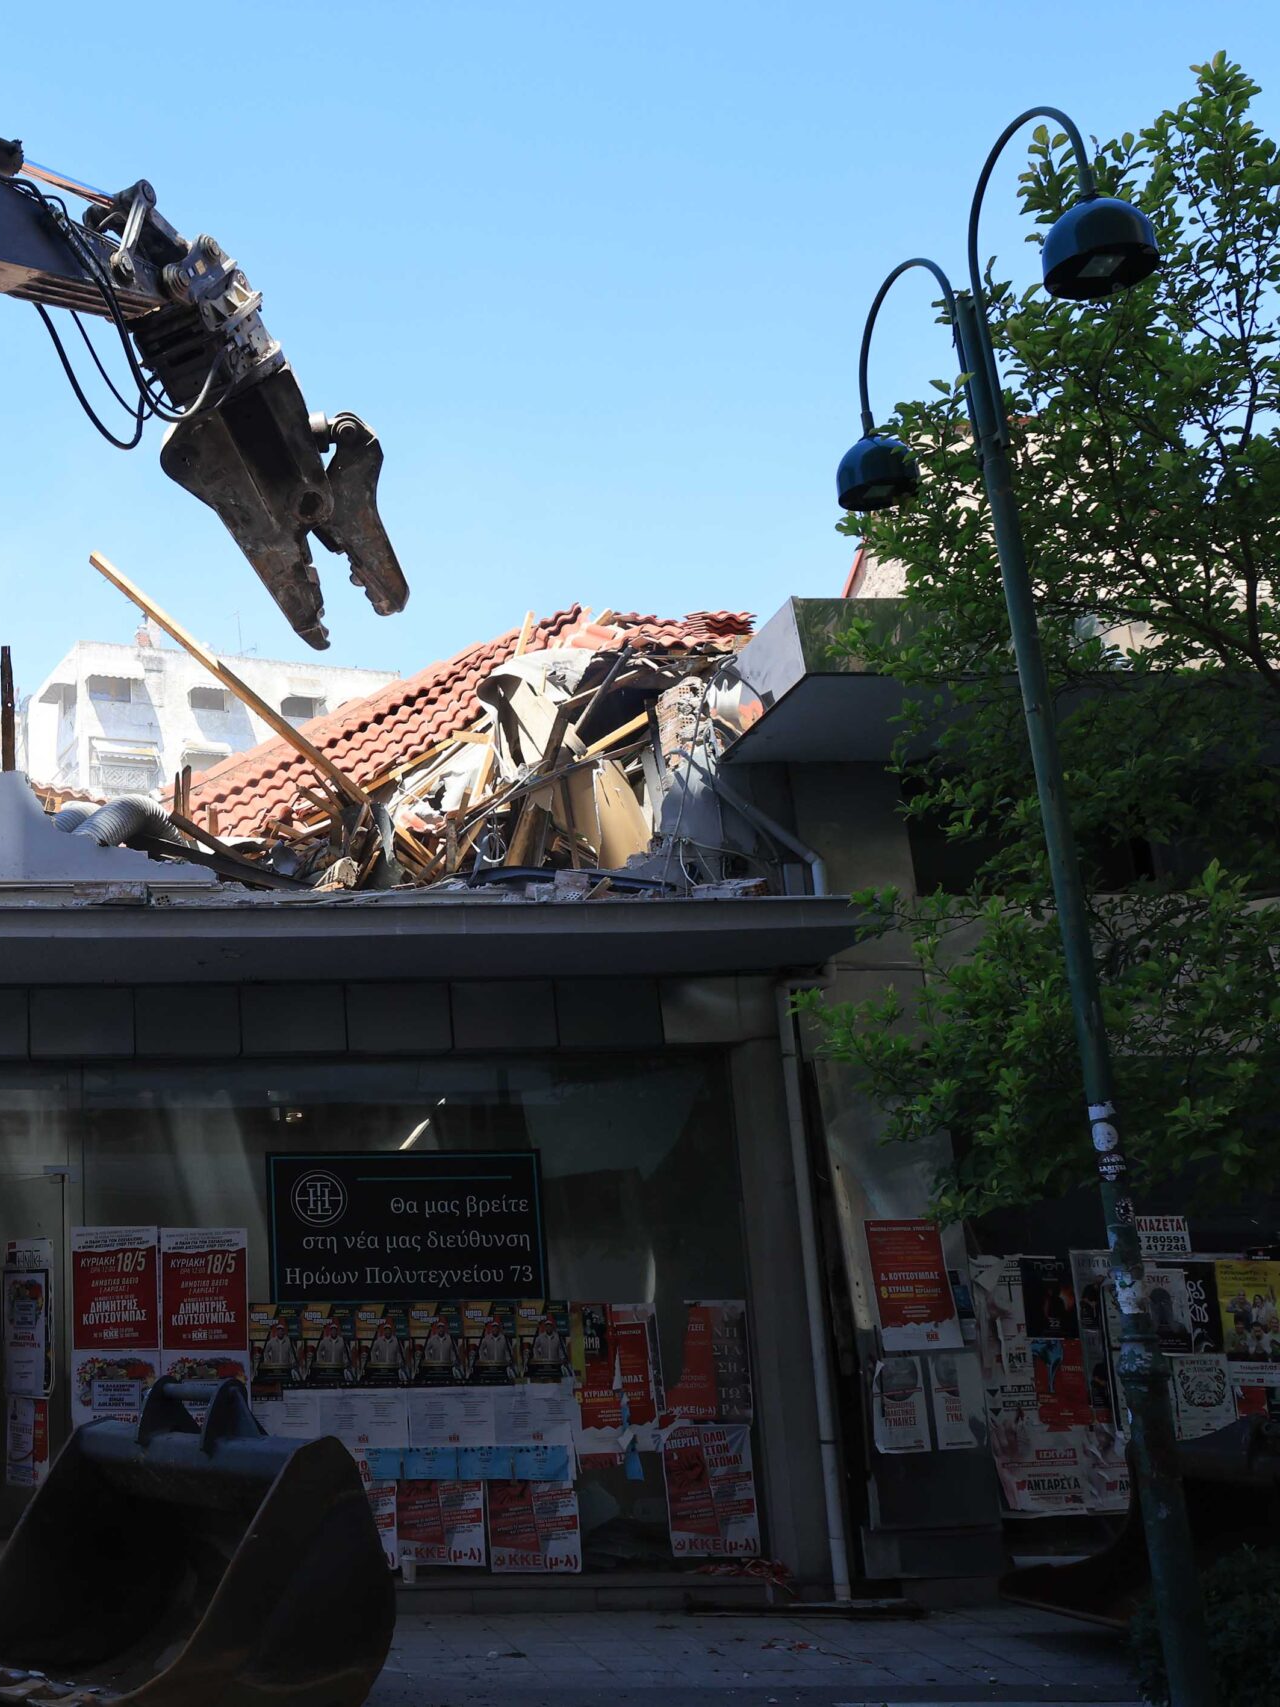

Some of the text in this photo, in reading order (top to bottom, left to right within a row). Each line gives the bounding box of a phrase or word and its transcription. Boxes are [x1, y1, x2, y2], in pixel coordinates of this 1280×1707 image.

[390, 1195, 528, 1217] Θα μας βρείτε
[1136, 1218, 1187, 1232] ΚΙΑΖΕΤΑΙ
[303, 1231, 531, 1253] στη νέα μας διεύθυνση
[80, 1251, 146, 1273] ΚΥΡΙΑΚΗ 18/5
[170, 1253, 237, 1274] ΚΥΡΙΑΚΗ 18/5
[285, 1265, 533, 1288] Ηρώων Πολυτεχνείου 73
[889, 1272, 939, 1280] ΚΟΥΤΣΟΥΜΠΑΣ
[91, 1279, 120, 1287] ΔΗΜΟΤΙΚΟ
[181, 1280, 210, 1288] ΔΗΜΟΤΙΚΟ
[90, 1299, 138, 1312] ΔΗΜΗΤΡΗΣ
[179, 1300, 228, 1313] ΔΗΜΗΤΡΗΣ
[82, 1309, 147, 1326] ΚΟΥΤΣΟΥΜΠΑΣ
[171, 1311, 236, 1326] ΚΟΥΤΣΟΥΜΠΑΣ
[104, 1329, 119, 1339] ΚΚΕ
[192, 1331, 208, 1340] ΚΚΕ
[720, 1388, 741, 1398] ΤΩ
[885, 1417, 917, 1427] ΓΥΝΑΙΚΕΣ
[703, 1430, 727, 1443] ΟΛΟΙ
[666, 1437, 700, 1450] ΑΠΕΡΓΙΑ
[704, 1444, 730, 1456] ΣΤΟΝ
[708, 1454, 743, 1468] ΑΓΩΝΑ!
[688, 1538, 757, 1554] ΚΚΕ(μ-λ)
[414, 1547, 482, 1563] ΚΚΕ(μ-λ)
[508, 1554, 578, 1569] ΚΚΕ(μ-λ)
